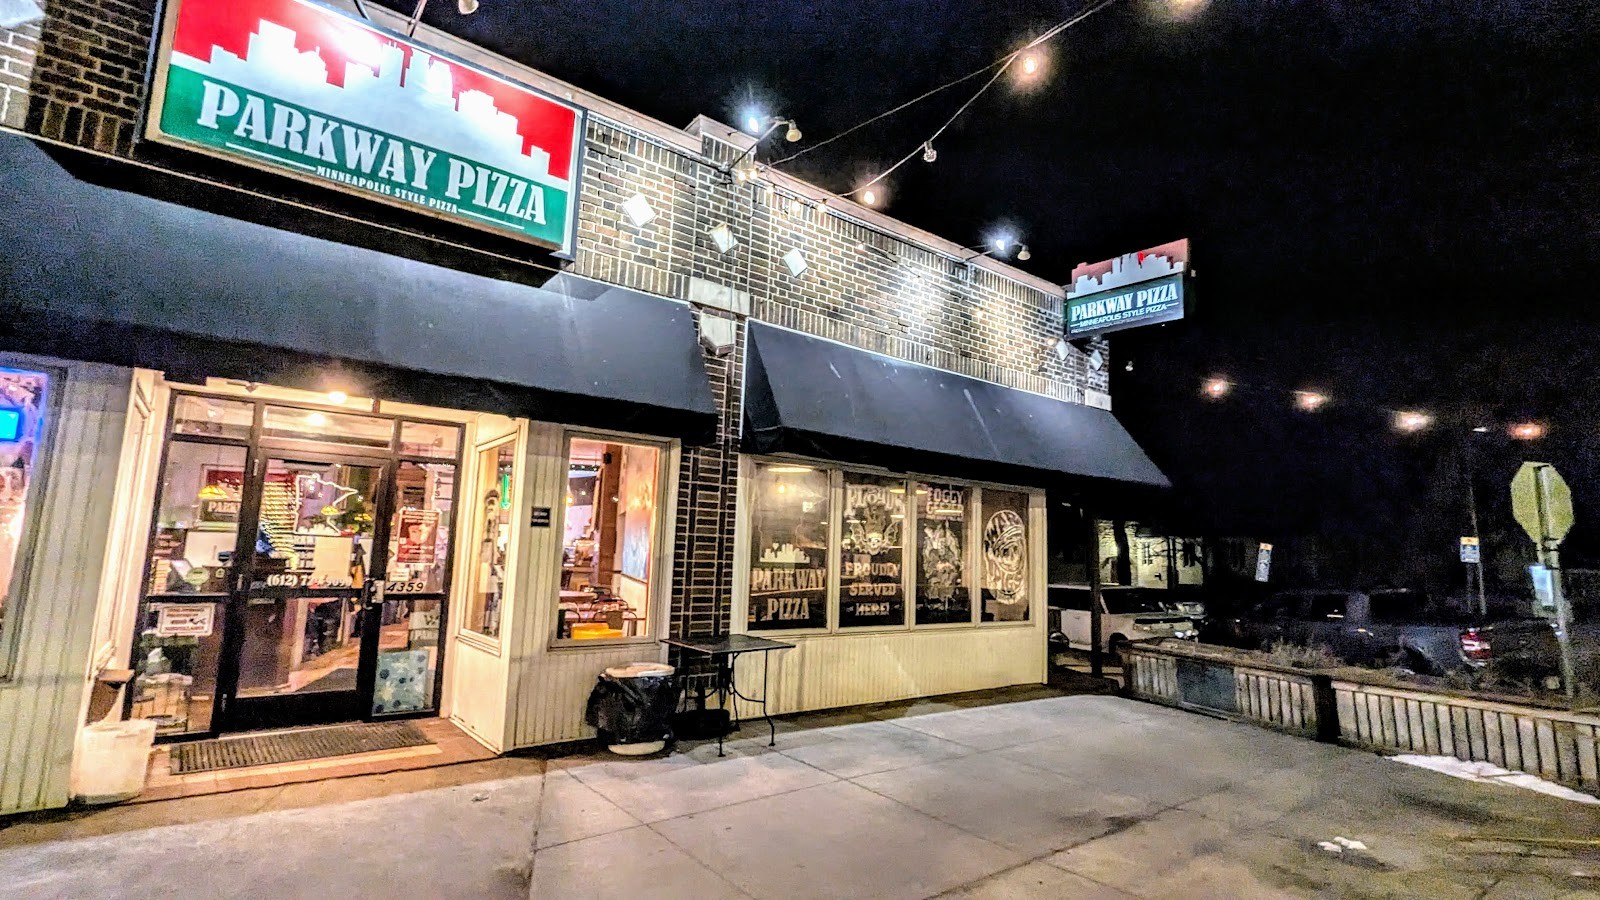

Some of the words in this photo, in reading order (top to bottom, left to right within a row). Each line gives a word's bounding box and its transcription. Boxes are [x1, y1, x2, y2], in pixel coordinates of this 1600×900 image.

[197, 80, 437, 190] PARKWAY
[445, 158, 546, 225] PIZZA
[316, 166, 391, 195] MINNEAPOLIS
[394, 187, 425, 205] STYLE
[429, 198, 457, 213] PIZZA
[1071, 293, 1133, 321] PARKWAY
[1137, 283, 1178, 307] PIZZA
[1080, 312, 1122, 327] MINNEAPOLIS
[1123, 307, 1145, 318] STYLE
[1146, 303, 1168, 314] PIZZA
[267, 574, 298, 587] (612)
[751, 567, 826, 591] PARKWAY
[845, 560, 900, 578] PROUDLY
[386, 582, 424, 592] 4359
[849, 582, 897, 596] SERVED
[763, 598, 810, 620] PIZZA
